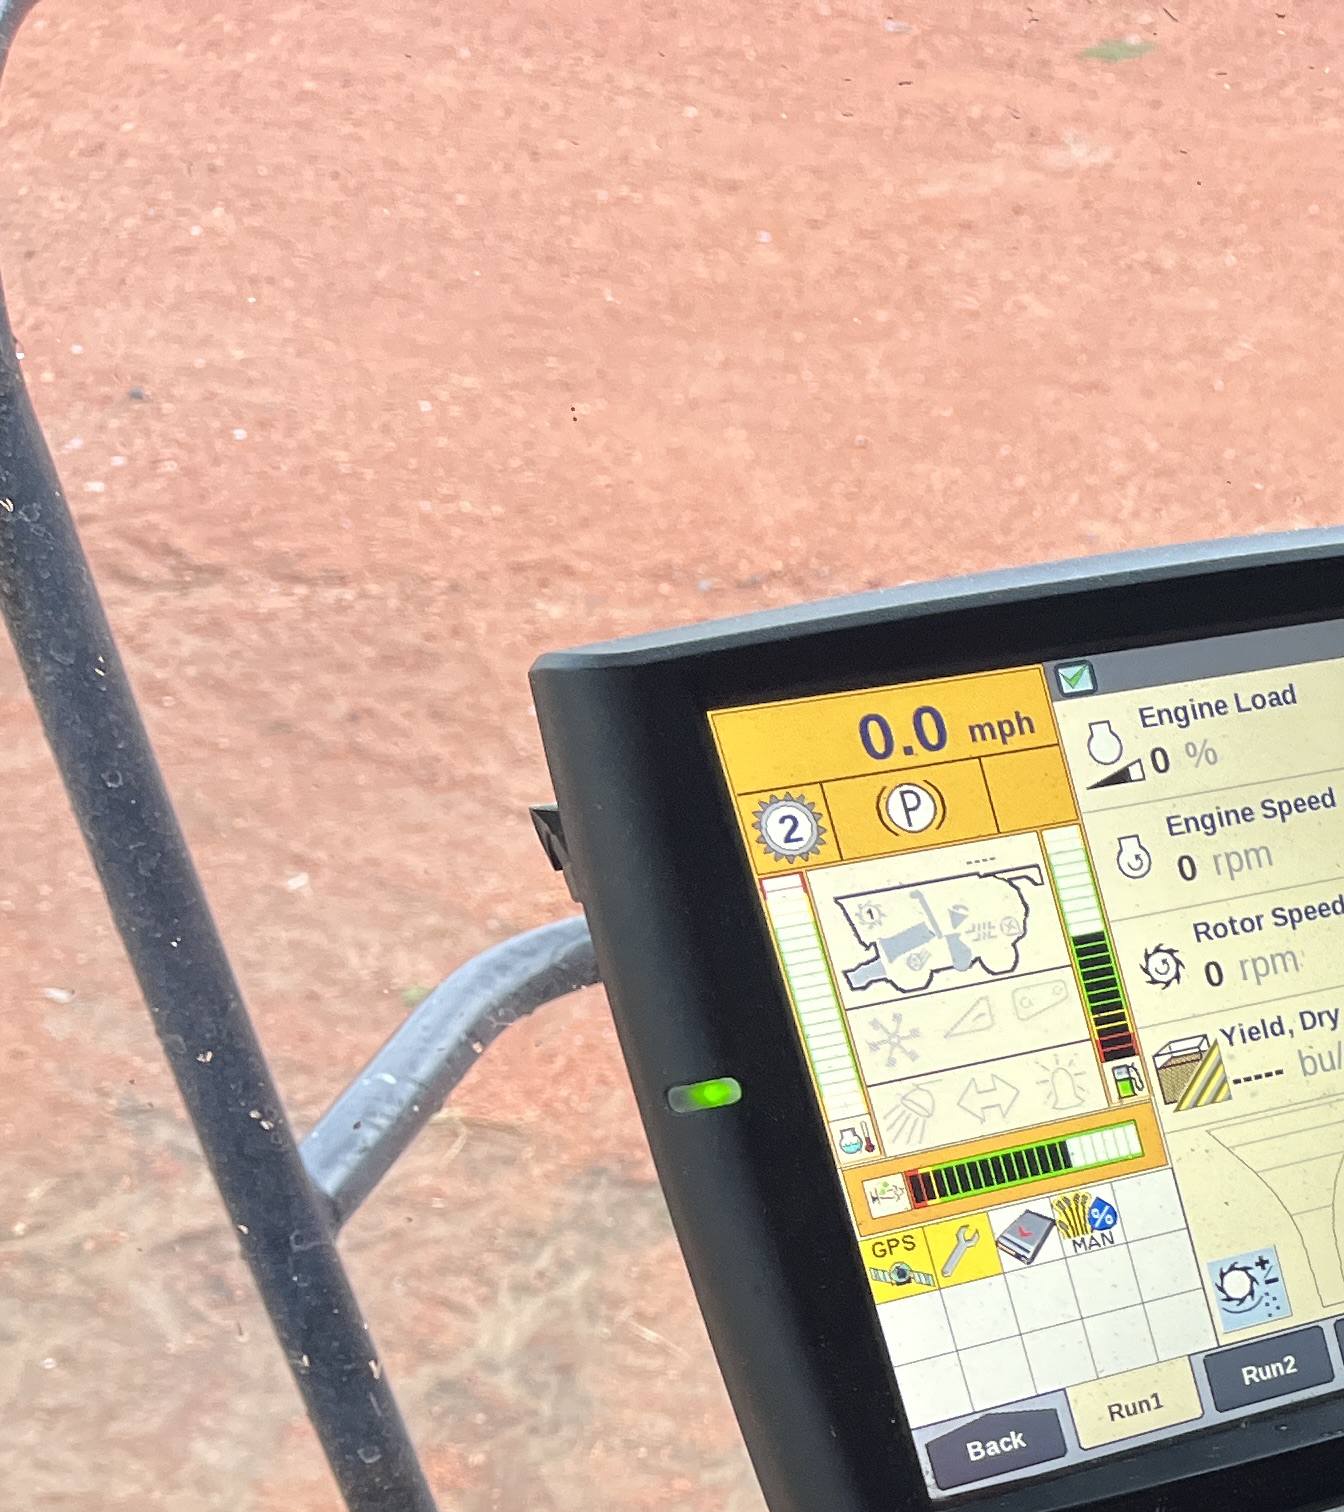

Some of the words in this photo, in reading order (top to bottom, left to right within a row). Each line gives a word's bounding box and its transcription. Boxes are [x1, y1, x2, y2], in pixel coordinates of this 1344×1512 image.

[1138, 698, 1228, 728] Engine
[1235, 684, 1297, 713] Load
[859, 705, 947, 760] 0.0
[968, 711, 1035, 745] mph
[1150, 747, 1170, 773] 0
[1185, 739, 1218, 768] %
[899, 790, 921, 827] P
[1166, 806, 1255, 836] Engine
[1261, 787, 1336, 823] Speed
[778, 814, 803, 843] 2
[1177, 855, 1197, 881] 0
[1212, 845, 1273, 880] rpm
[1192, 914, 1264, 942] Rotor
[1204, 961, 1224, 987] 0
[1239, 951, 1299, 985] rpm
[1220, 1016, 1294, 1046] Yield,
[1299, 1008, 1340, 1031] Dry
[871, 1235, 916, 1258] GPS
[1072, 1231, 1114, 1253] MAN
[1241, 1355, 1297, 1385] Run2
[1108, 1393, 1164, 1422] Run1
[966, 1432, 1026, 1461] Back
